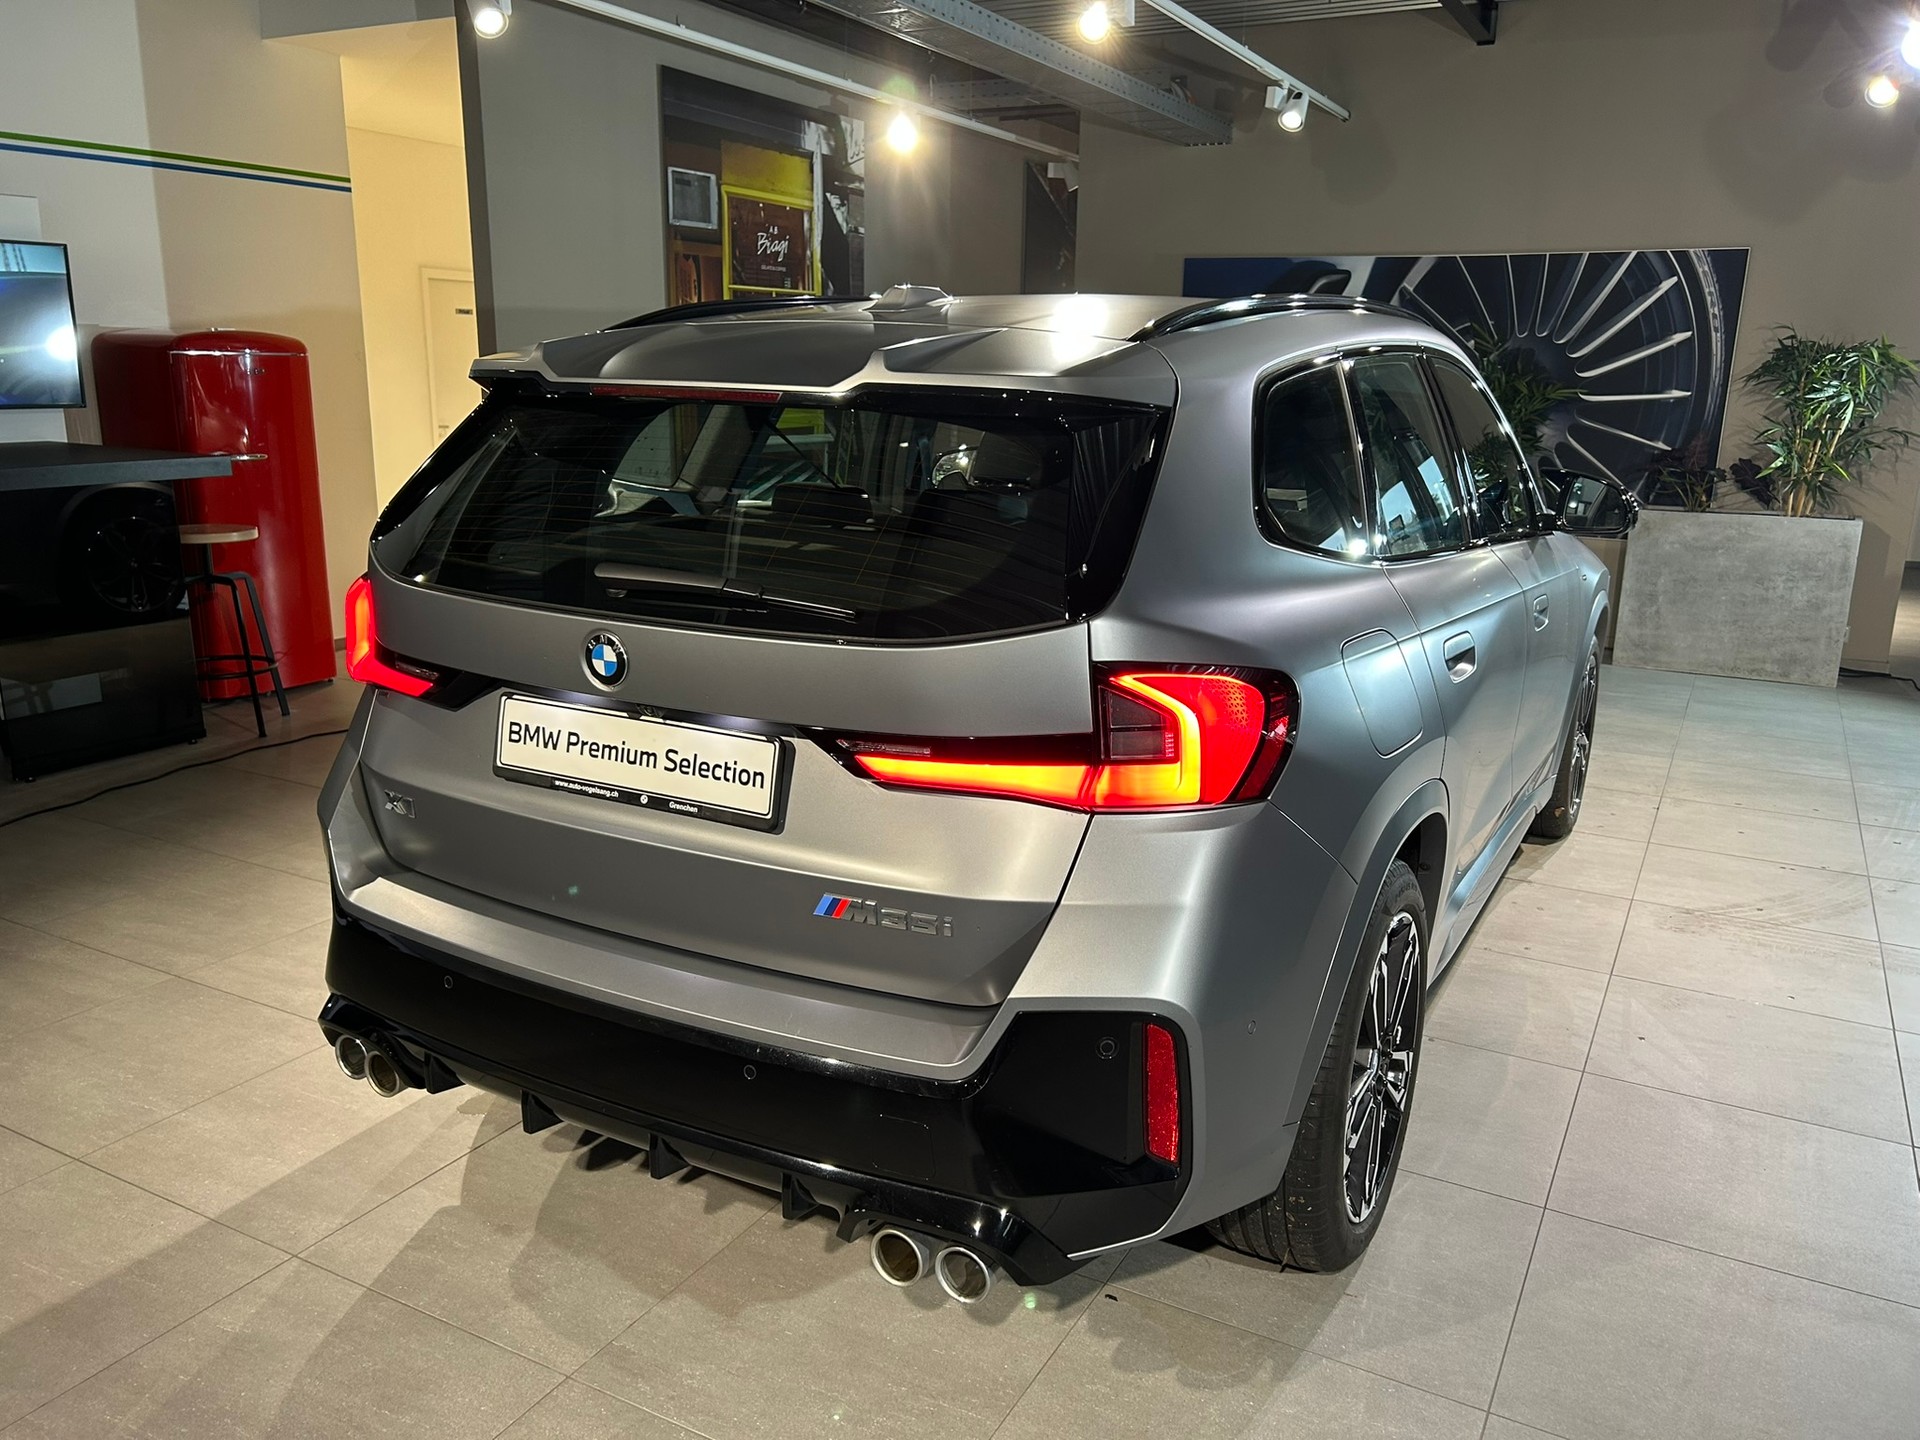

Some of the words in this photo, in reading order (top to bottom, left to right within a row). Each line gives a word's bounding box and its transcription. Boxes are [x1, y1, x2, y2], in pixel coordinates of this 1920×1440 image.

[757, 232, 789, 262] Biagi
[588, 633, 622, 653] BMW
[508, 721, 561, 751] BMW
[566, 731, 657, 769] Premium
[664, 748, 765, 789] Selection
[554, 779, 619, 798] www.auto-vogelsang.ch
[669, 801, 698, 814] Grenchen
[841, 896, 953, 937] M35i
